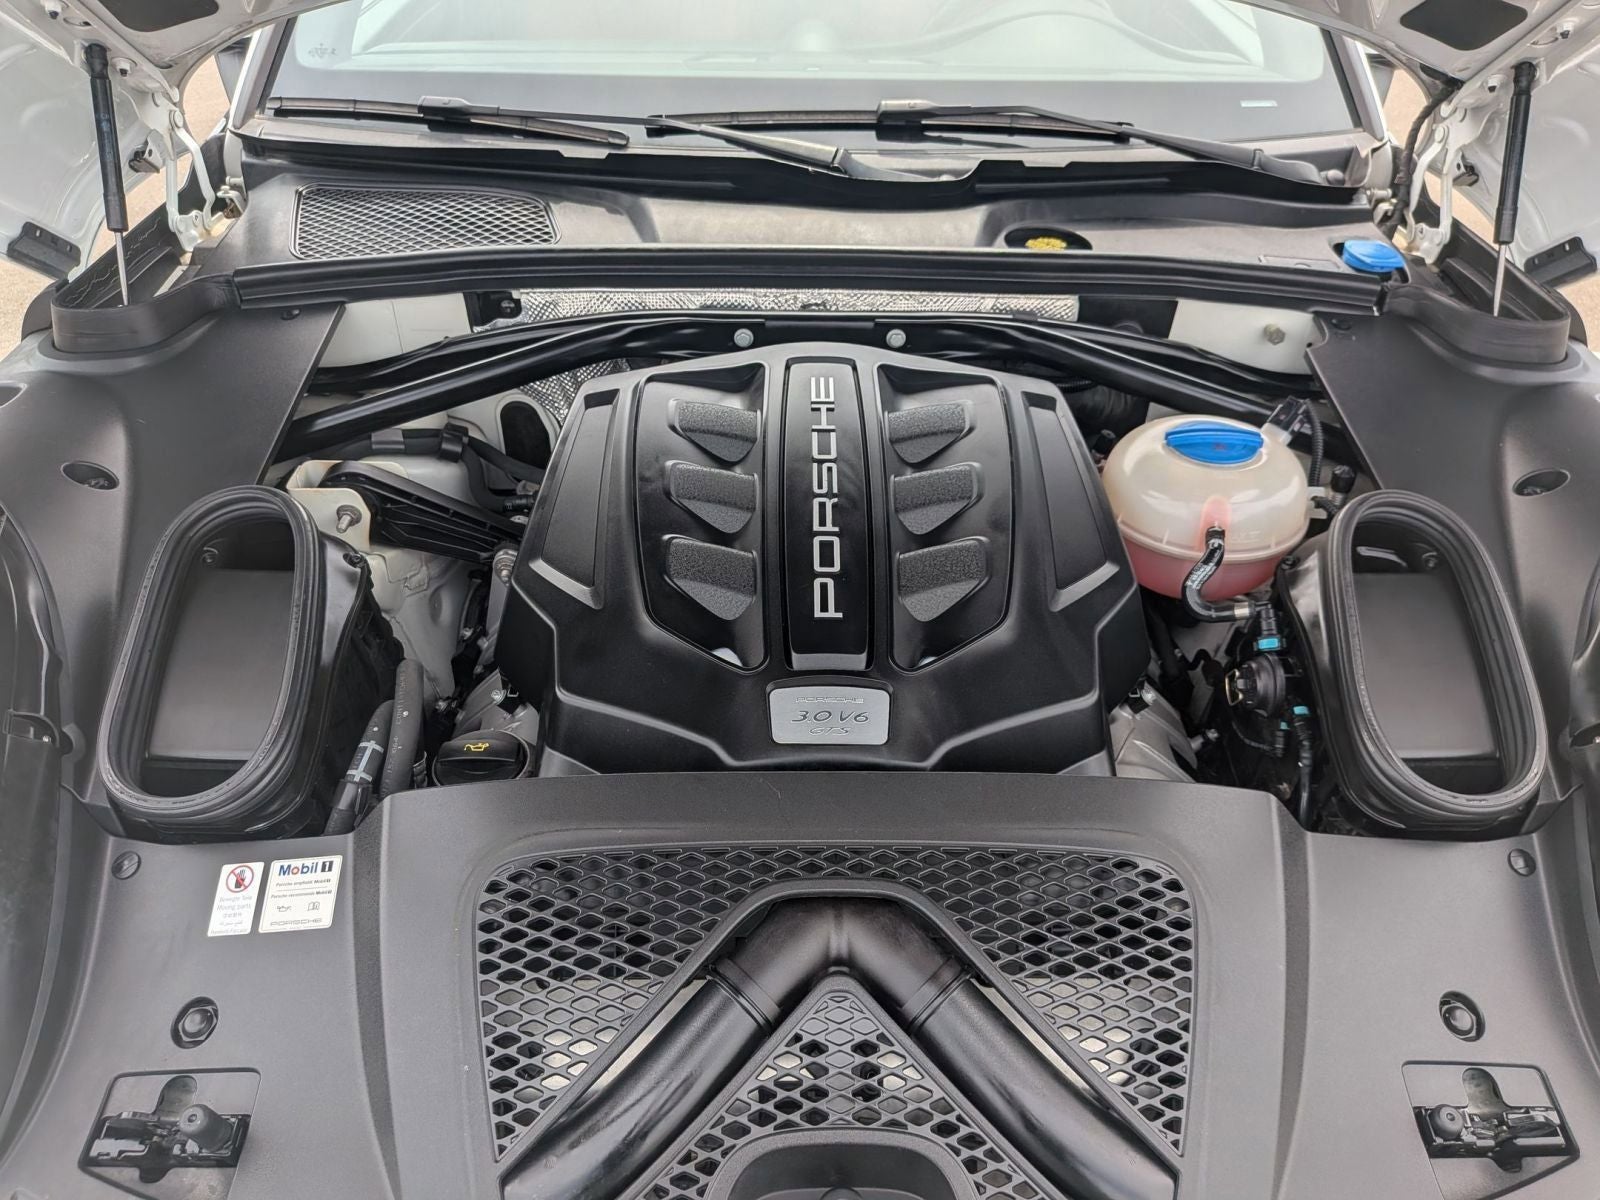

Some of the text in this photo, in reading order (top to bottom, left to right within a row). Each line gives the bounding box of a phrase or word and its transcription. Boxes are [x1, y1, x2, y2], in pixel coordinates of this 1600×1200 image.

[810, 376, 843, 618] PORSCHE
[795, 696, 864, 704] PORSCHE
[791, 710, 869, 723] 3.0 V6
[809, 726, 850, 736] GTS
[278, 861, 319, 876] Mobil
